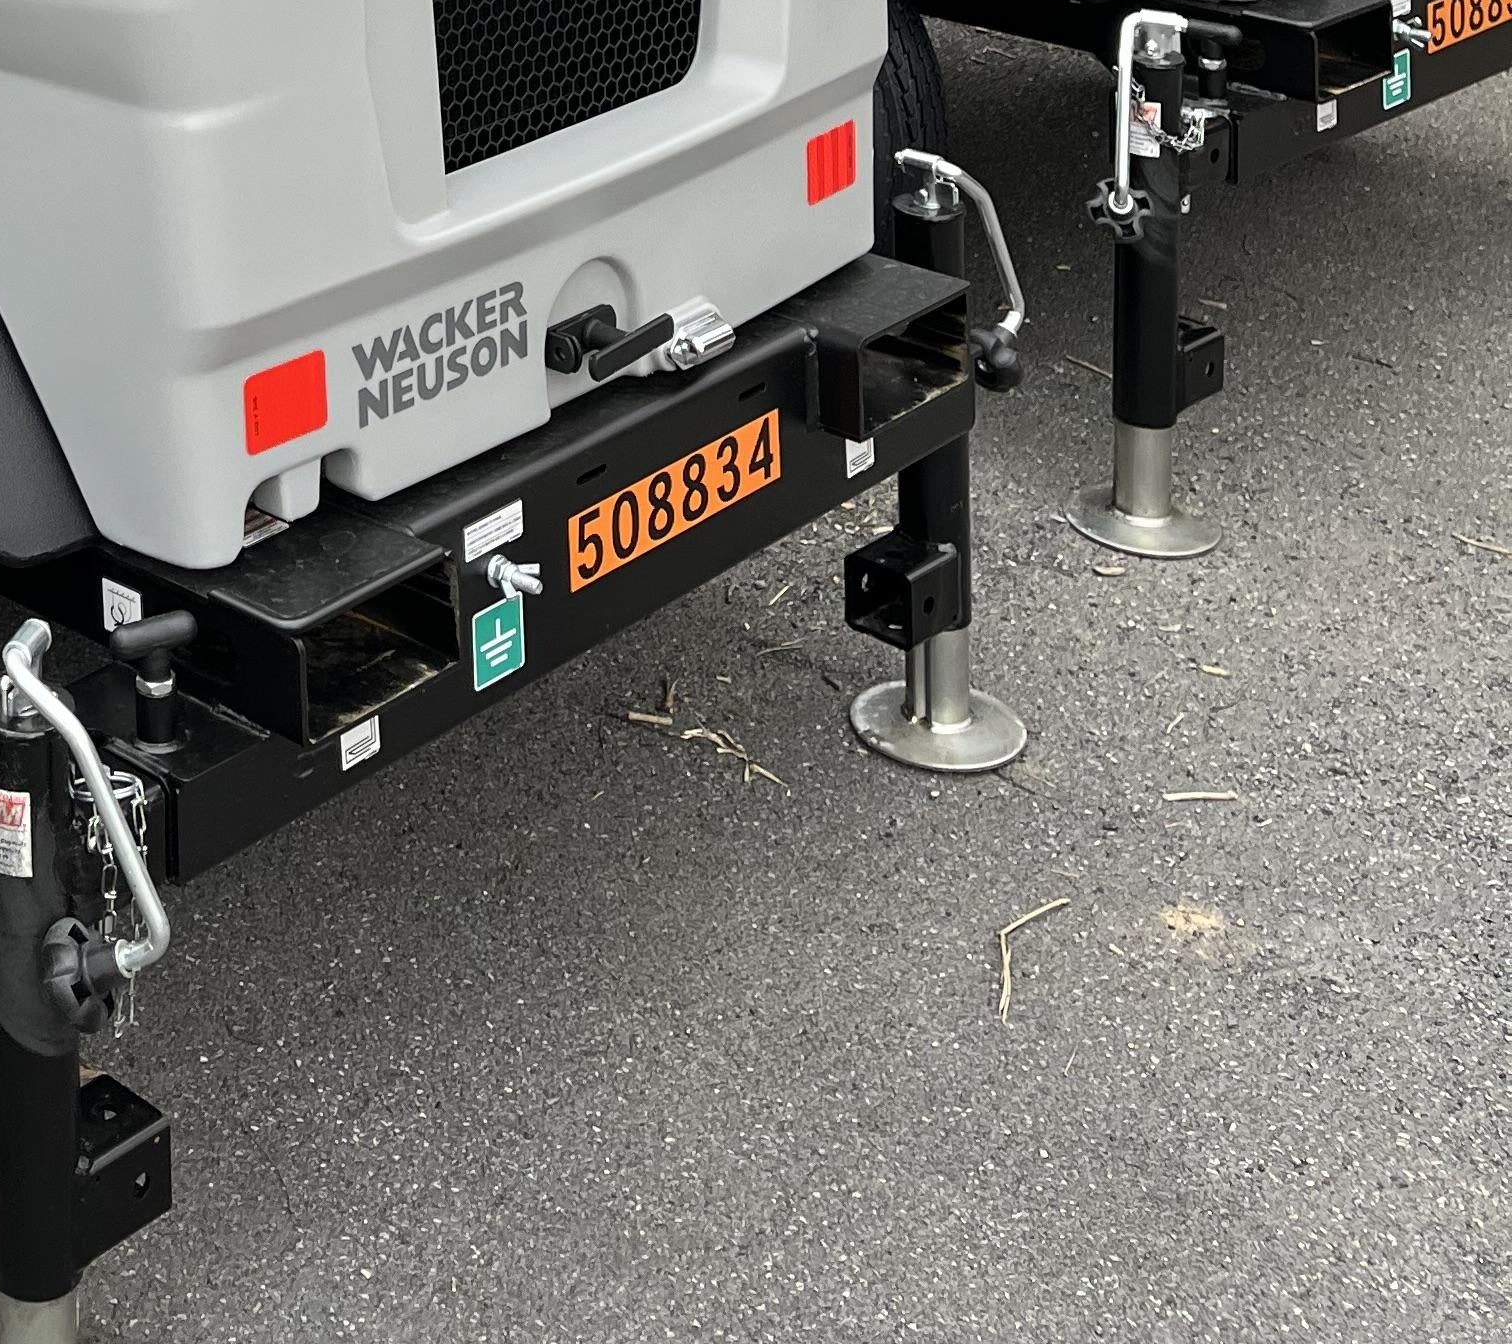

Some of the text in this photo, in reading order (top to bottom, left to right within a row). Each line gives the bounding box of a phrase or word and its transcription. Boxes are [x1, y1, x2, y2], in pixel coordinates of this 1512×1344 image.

[351, 281, 528, 382] WACKER
[358, 320, 528, 429] NEUSON
[577, 417, 774, 579] 508834
